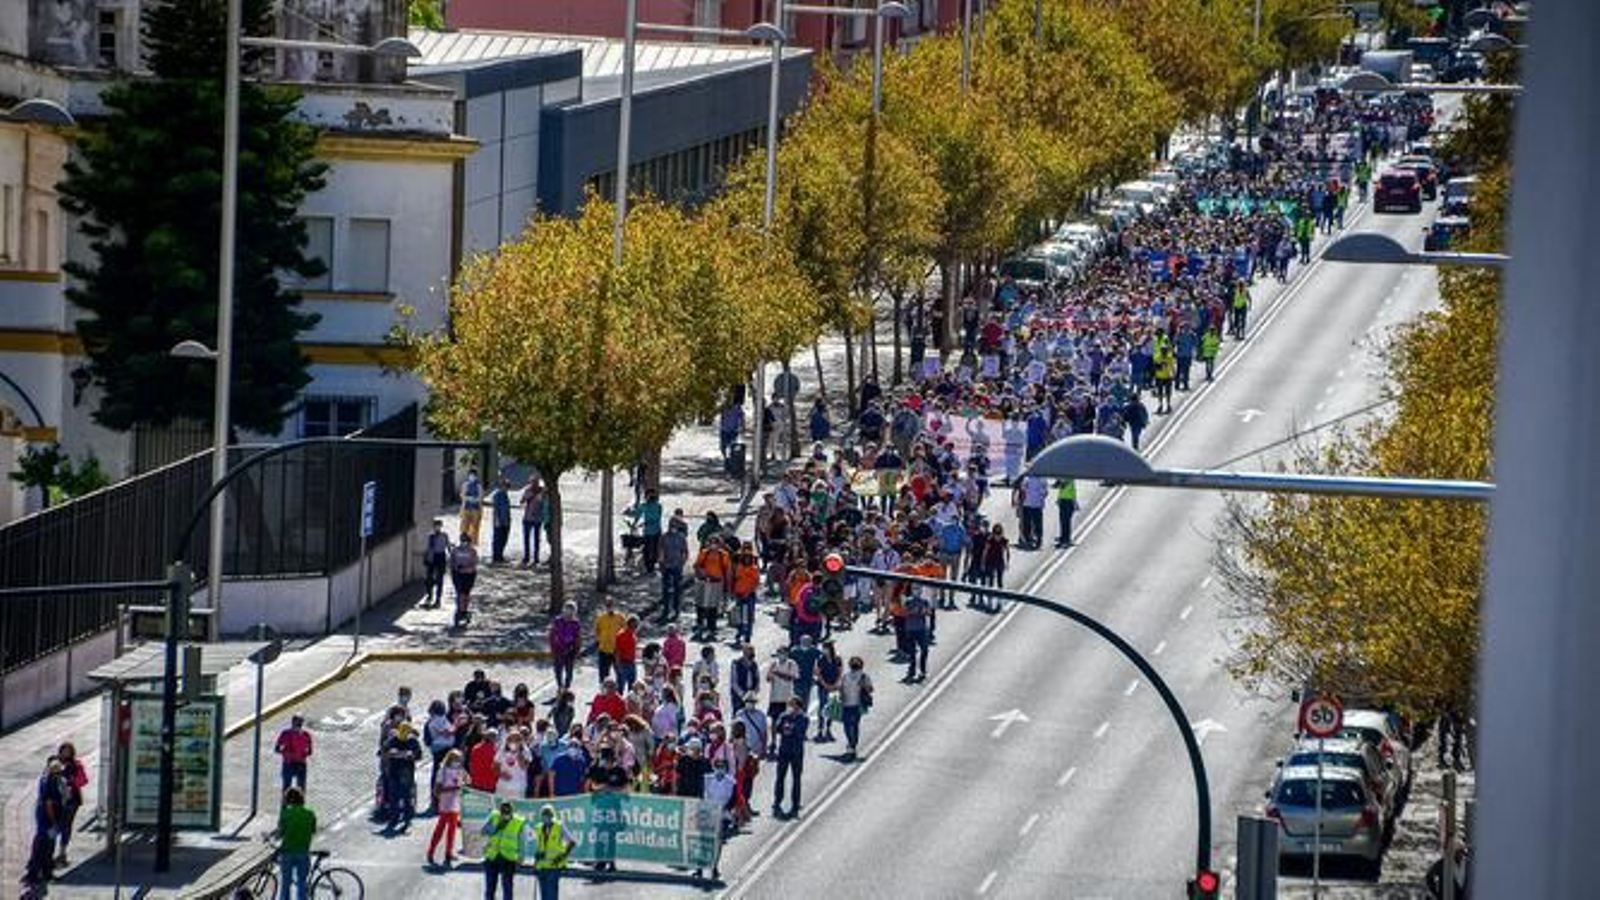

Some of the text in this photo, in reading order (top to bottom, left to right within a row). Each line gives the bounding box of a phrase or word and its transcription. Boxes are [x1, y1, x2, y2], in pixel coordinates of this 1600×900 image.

[1312, 709, 1334, 724] 50
[591, 806, 680, 830] sanidad
[588, 827, 609, 843] de
[615, 830, 679, 847] calidad
